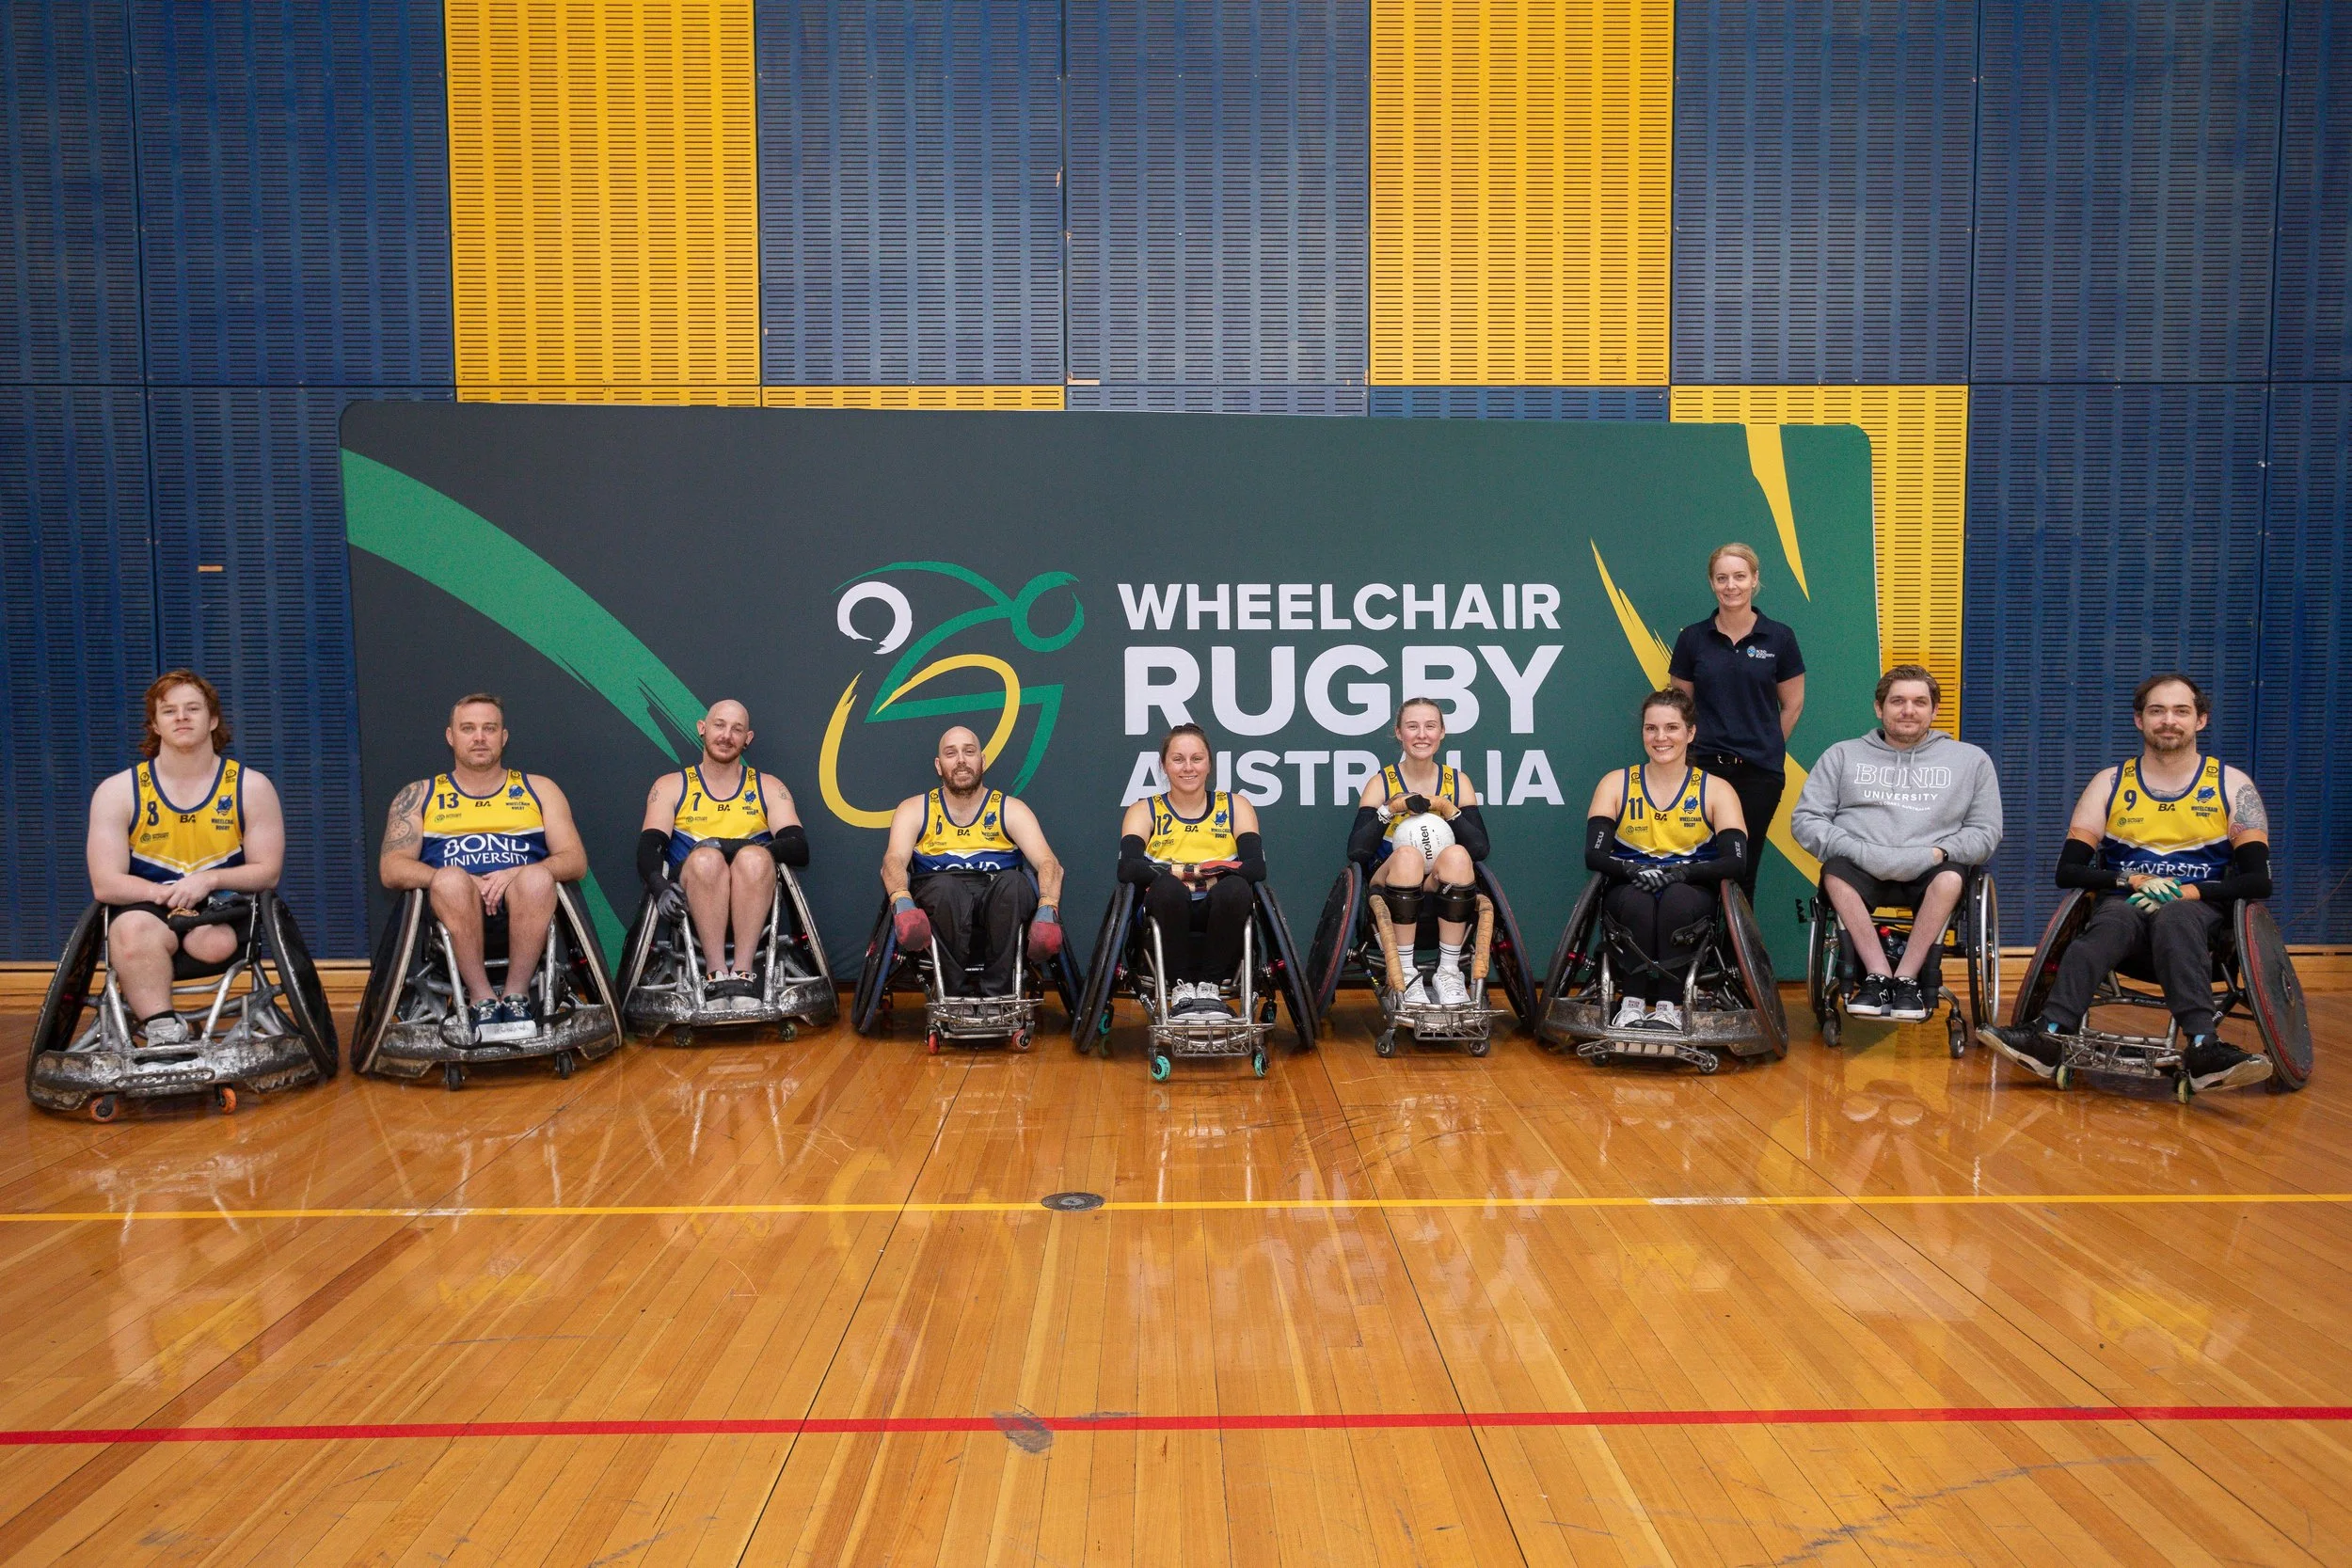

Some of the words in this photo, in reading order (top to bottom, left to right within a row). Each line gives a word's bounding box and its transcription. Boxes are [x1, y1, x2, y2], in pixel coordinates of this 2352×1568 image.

[1117, 583, 1562, 630] WHEELCHAIR
[1124, 644, 1565, 736] RUGBY
[1120, 750, 1565, 806] ASTRIA
[1854, 763, 1951, 788] BOND
[437, 792, 459, 810] 13
[1864, 790, 1938, 801] UNIVERSITY
[2123, 789, 2137, 811] 9
[147, 800, 159, 826] 8
[1629, 797, 1644, 820] 11
[1156, 813, 1172, 835] 12
[1421, 825, 1433, 860] molten
[444, 852, 528, 866] UNIVERSITY
[2121, 862, 2211, 879] IVERSITY
